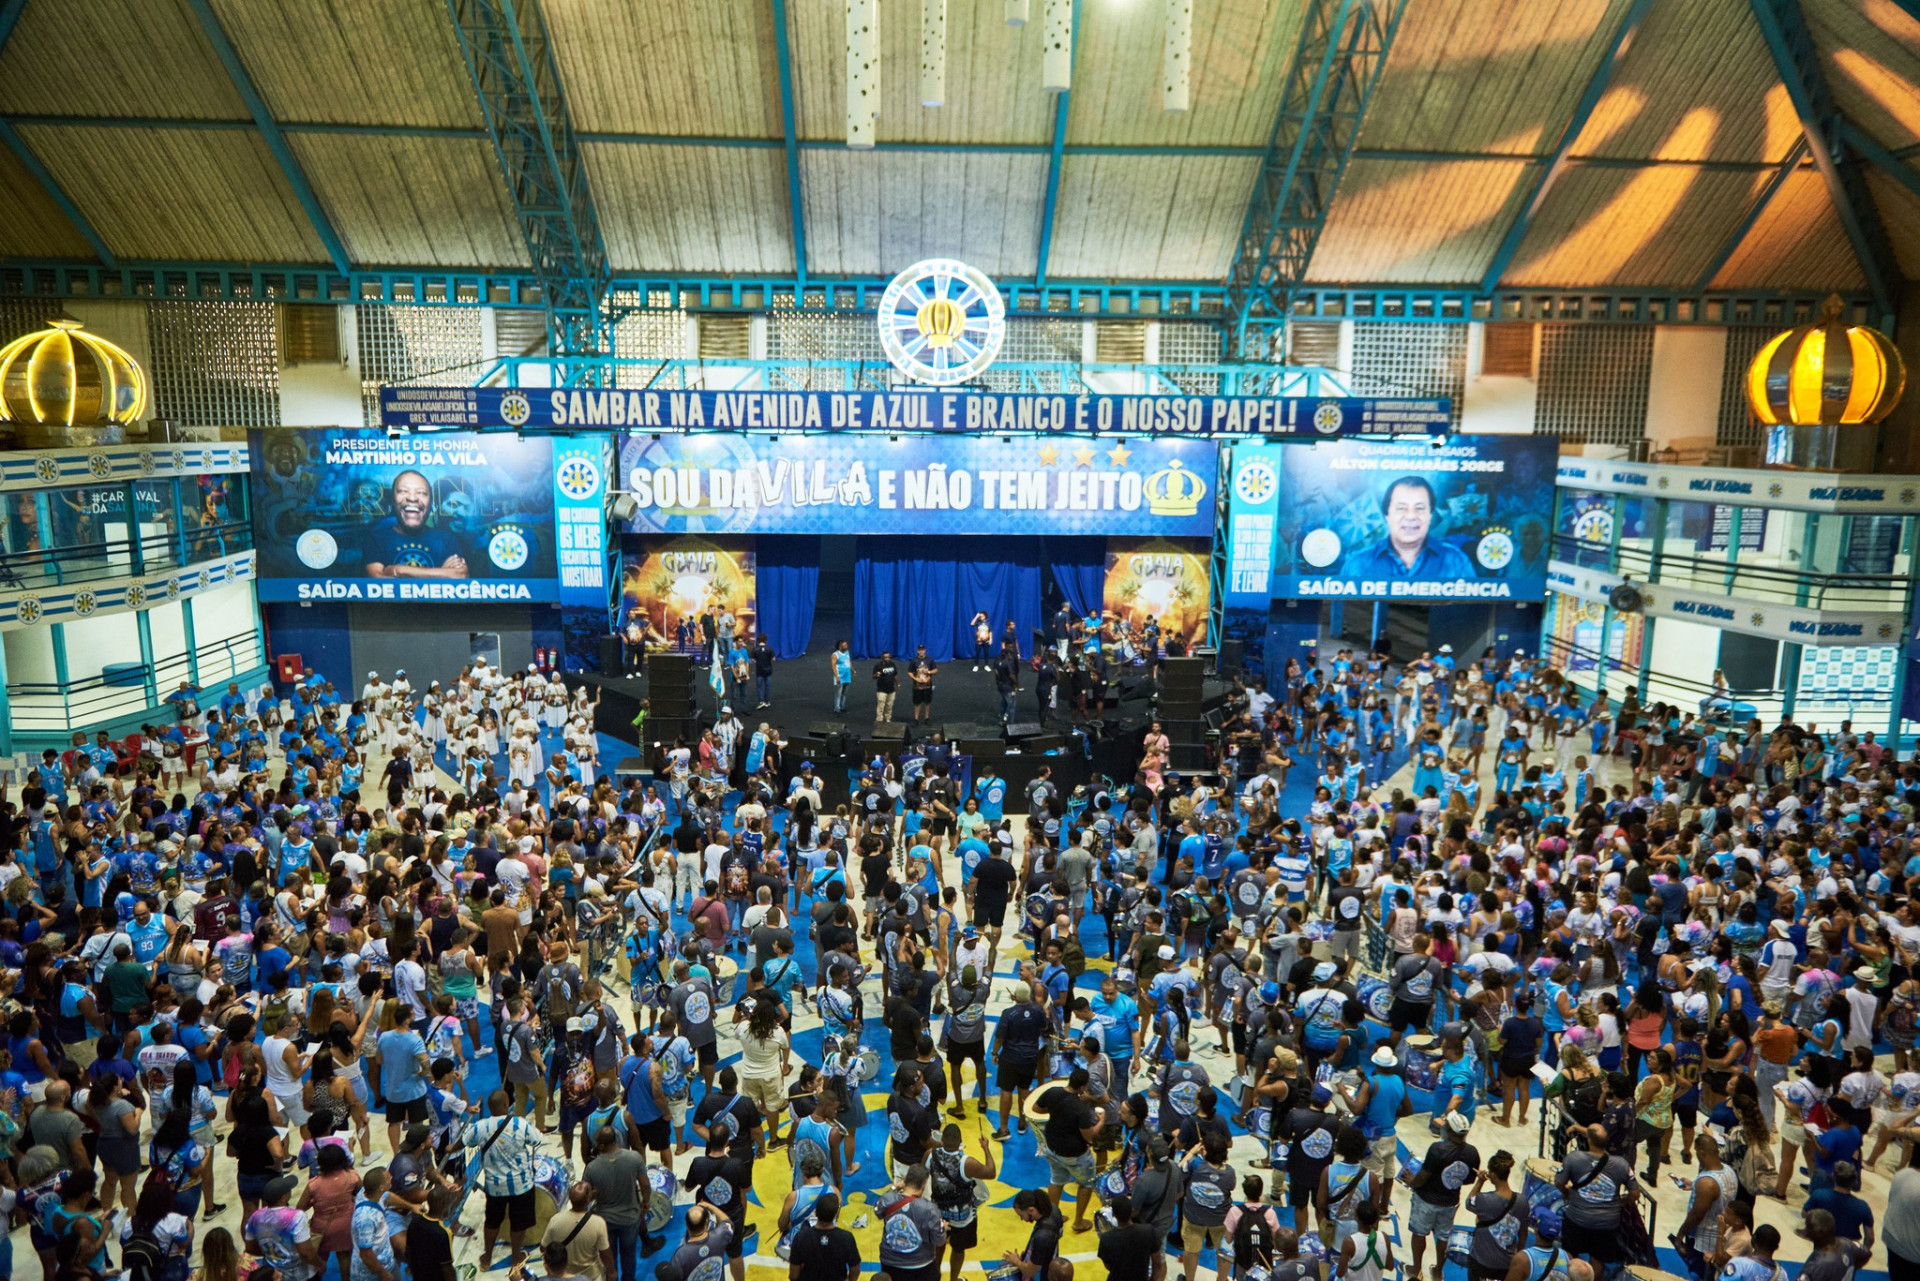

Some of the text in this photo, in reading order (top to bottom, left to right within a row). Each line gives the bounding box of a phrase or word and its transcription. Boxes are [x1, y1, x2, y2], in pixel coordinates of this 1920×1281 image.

[551, 391, 1296, 432] SAMBAR NA AVENIDA DE AZUL E BRANCO É O NOSSO PAPEL!
[333, 439, 478, 450] PRESIDENTE DE HONRA
[1359, 446, 1408, 456] QUADRA
[1410, 446, 1425, 456] DE
[326, 451, 488, 465] MARTINHO DA VILA
[1380, 458, 1458, 471] GUIMARÃES
[1459, 460, 1504, 472] JORGE
[630, 457, 1142, 511] SOU DA VILA E NÃO TEM JEITO
[91, 490, 161, 502] #CARVAL
[1809, 487, 1837, 500] VILA
[560, 524, 600, 549] OS MEUS
[298, 579, 531, 599] SAÍDA DE EMERGÊNCIA
[1299, 577, 1511, 597] SAÍDA DE EMERGÊNCIA
[1789, 620, 1816, 635] VILA
[216, 911, 226, 928] 9
[141, 941, 154, 951] 93
